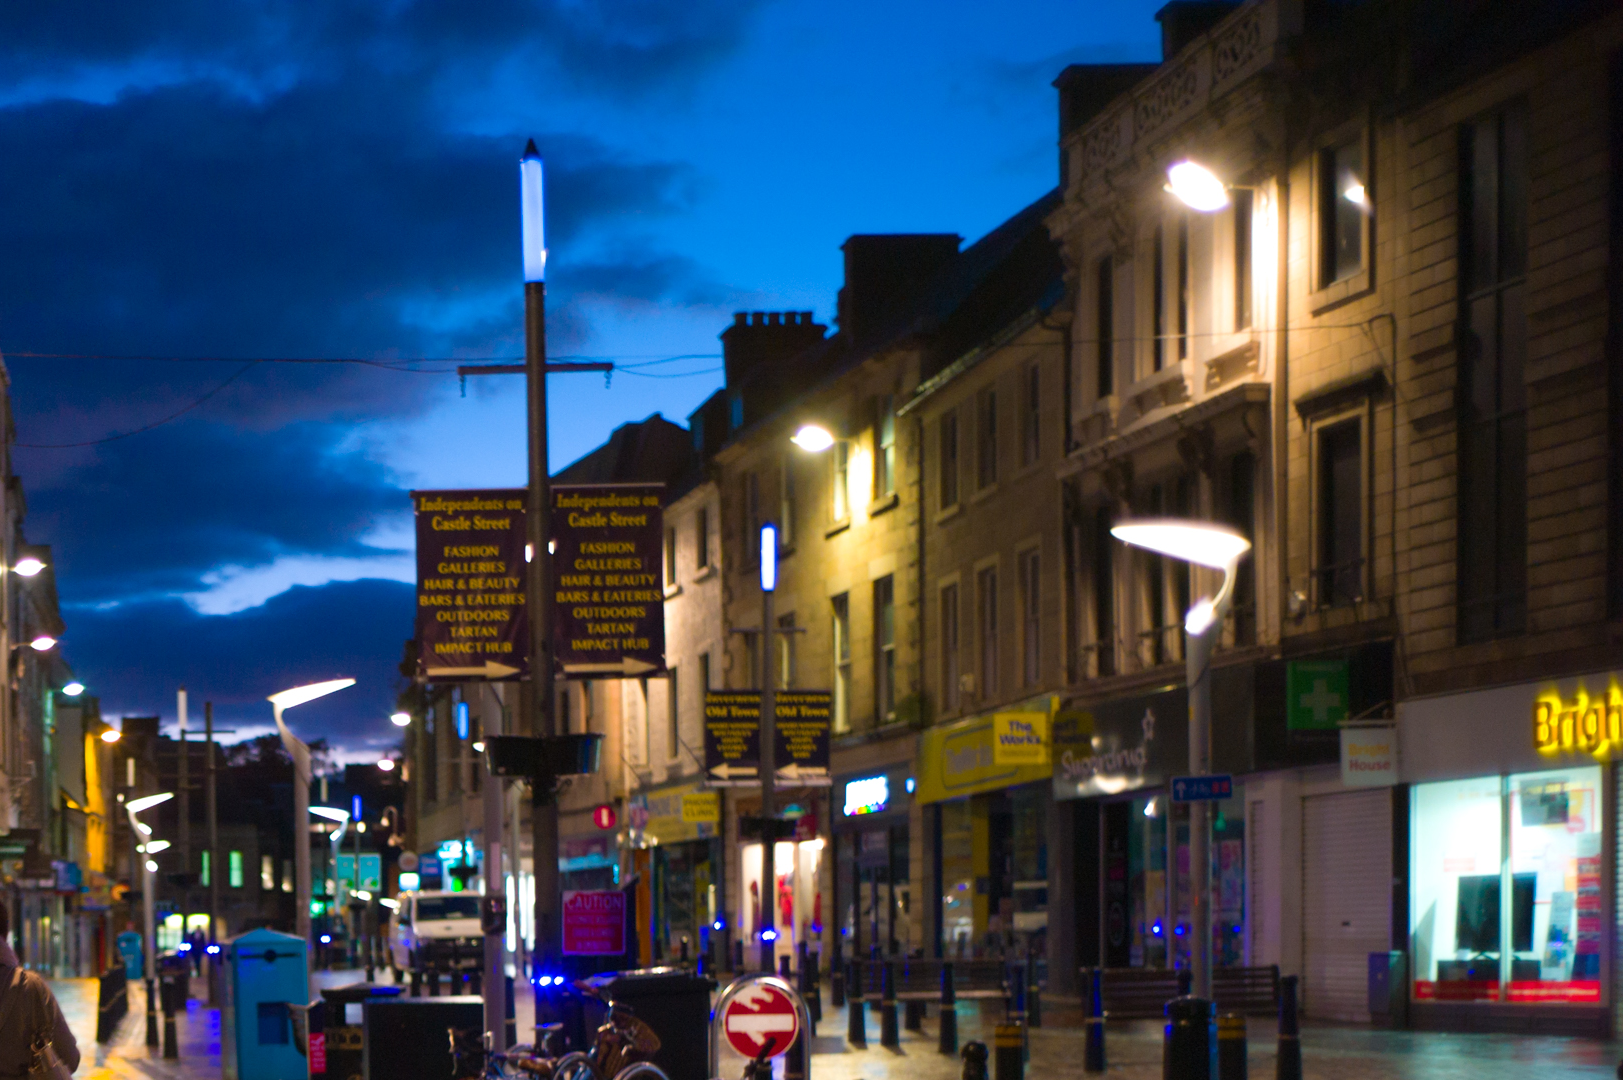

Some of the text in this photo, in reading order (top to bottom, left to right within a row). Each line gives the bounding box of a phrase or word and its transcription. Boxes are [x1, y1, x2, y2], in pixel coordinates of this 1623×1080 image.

[420, 496, 522, 515] Independents on
[557, 493, 658, 512] Independents on
[431, 515, 510, 531] Castle Street
[568, 511, 647, 527] Castle Street
[443, 546, 499, 557] FASHION
[580, 542, 635, 554] FASHION
[437, 562, 506, 574] GALLERIES
[574, 558, 642, 570] GALLERIES
[424, 577, 520, 590] HAIR & BEAUTY
[561, 574, 656, 586] HAIR & BEAUTY
[419, 593, 526, 606] BARS & EATERIES
[556, 590, 662, 603] BARS & EATERIES
[436, 610, 510, 622] OUTDOORS
[573, 606, 646, 619] OUTDOORS
[449, 626, 498, 637] TARTAN
[587, 622, 634, 634] TARTAN
[434, 642, 513, 654] IMPACT HUB
[572, 638, 650, 650] IMPACT HUB
[705, 705, 759, 717] Old Town
[776, 705, 829, 717] Old Town
[1009, 721, 1032, 733] The
[999, 735, 1041, 746] Works
[1349, 760, 1391, 772] House
[566, 895, 621, 911] CAUTION
